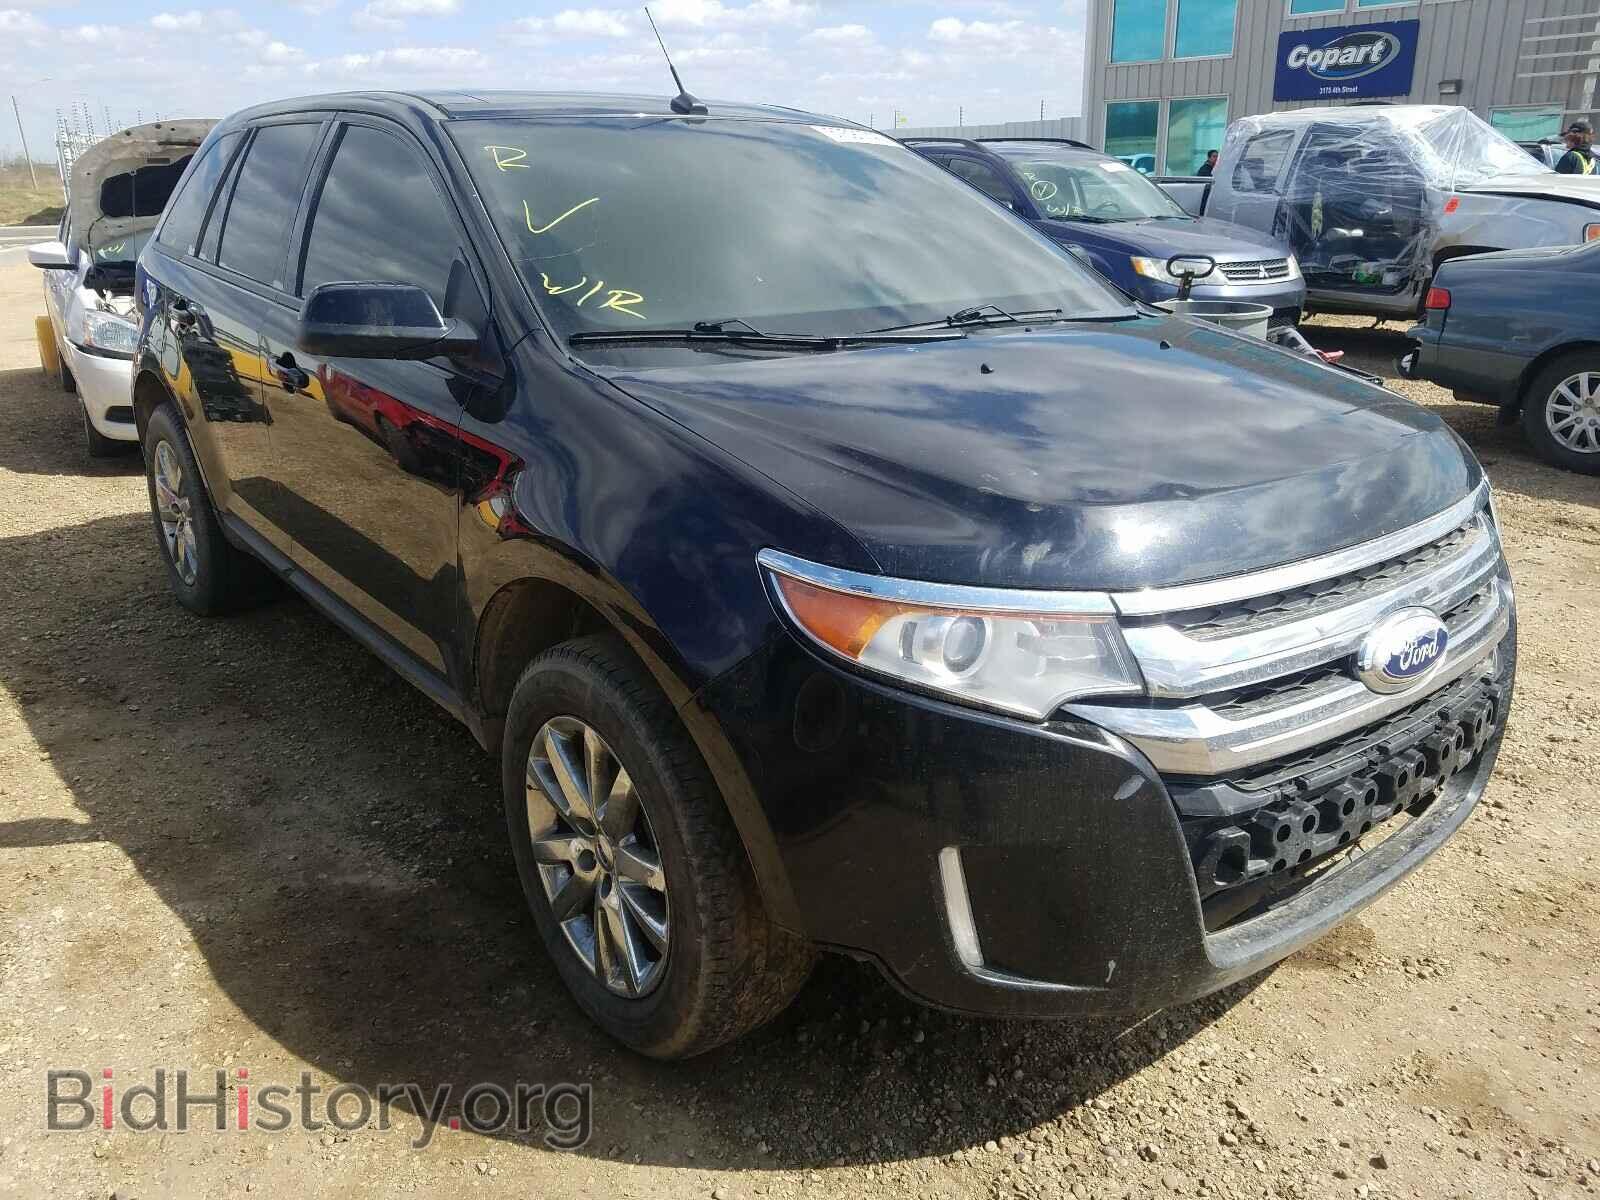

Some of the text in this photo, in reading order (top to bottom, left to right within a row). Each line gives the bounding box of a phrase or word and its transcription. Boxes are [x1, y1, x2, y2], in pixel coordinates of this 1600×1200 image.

[1287, 37, 1386, 72] Copart
[1342, 85, 1358, 93] Street
[1399, 628, 1439, 671] Ford
